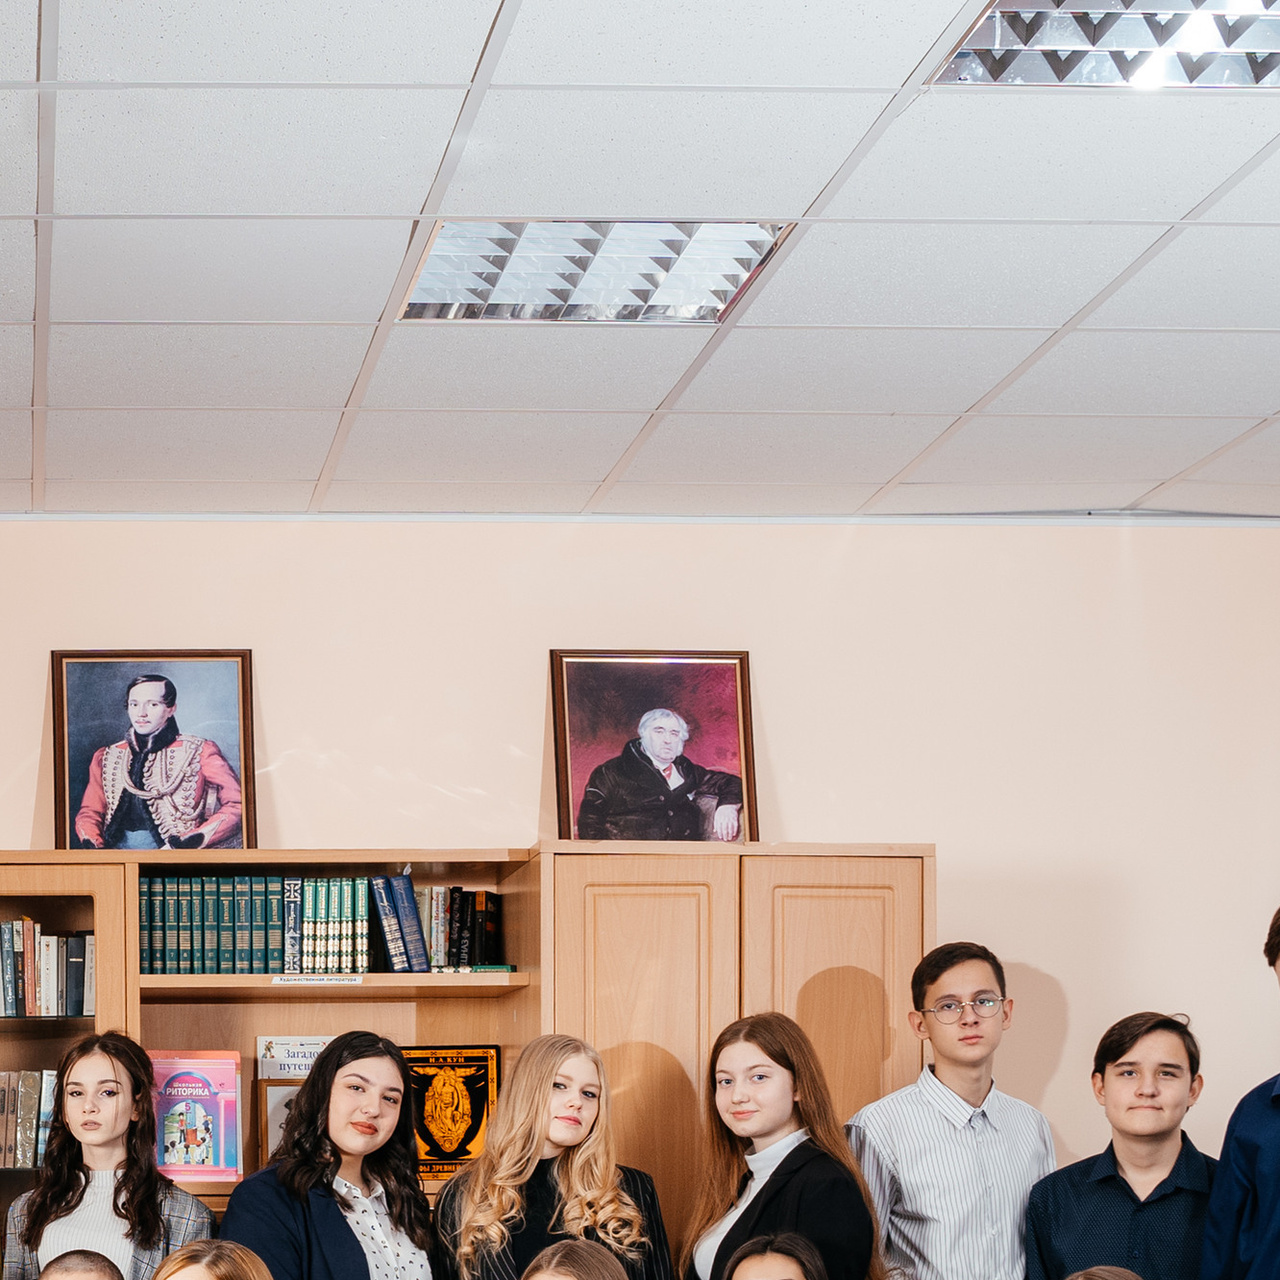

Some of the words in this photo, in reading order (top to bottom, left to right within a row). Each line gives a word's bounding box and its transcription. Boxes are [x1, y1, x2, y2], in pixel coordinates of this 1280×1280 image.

[284, 1049, 319, 1059] Загадо
[279, 1063, 312, 1073] путеш
[166, 1087, 210, 1096] РИТОРИКА
[184, 1102, 191, 1112] 5
[418, 1164, 430, 1172] ФЫ
